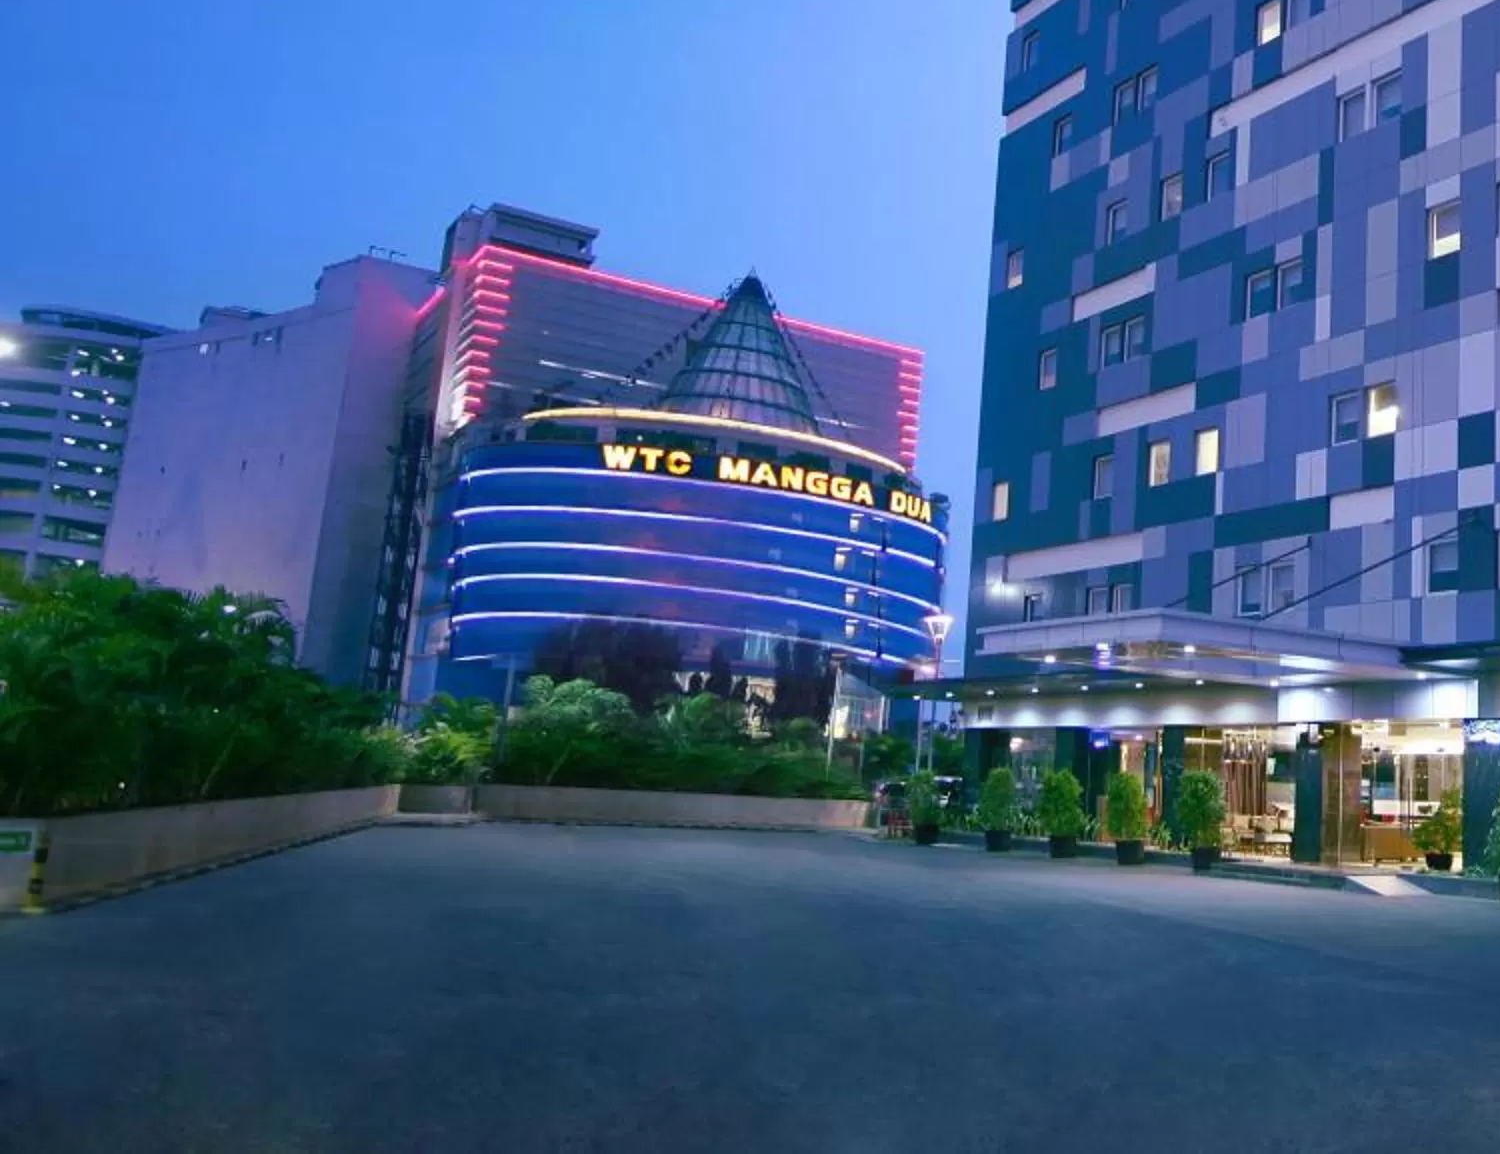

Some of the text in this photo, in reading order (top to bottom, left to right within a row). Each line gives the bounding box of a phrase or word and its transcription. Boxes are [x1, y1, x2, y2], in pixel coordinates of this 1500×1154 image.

[603, 444, 932, 524] WTC MANGGA DUA
